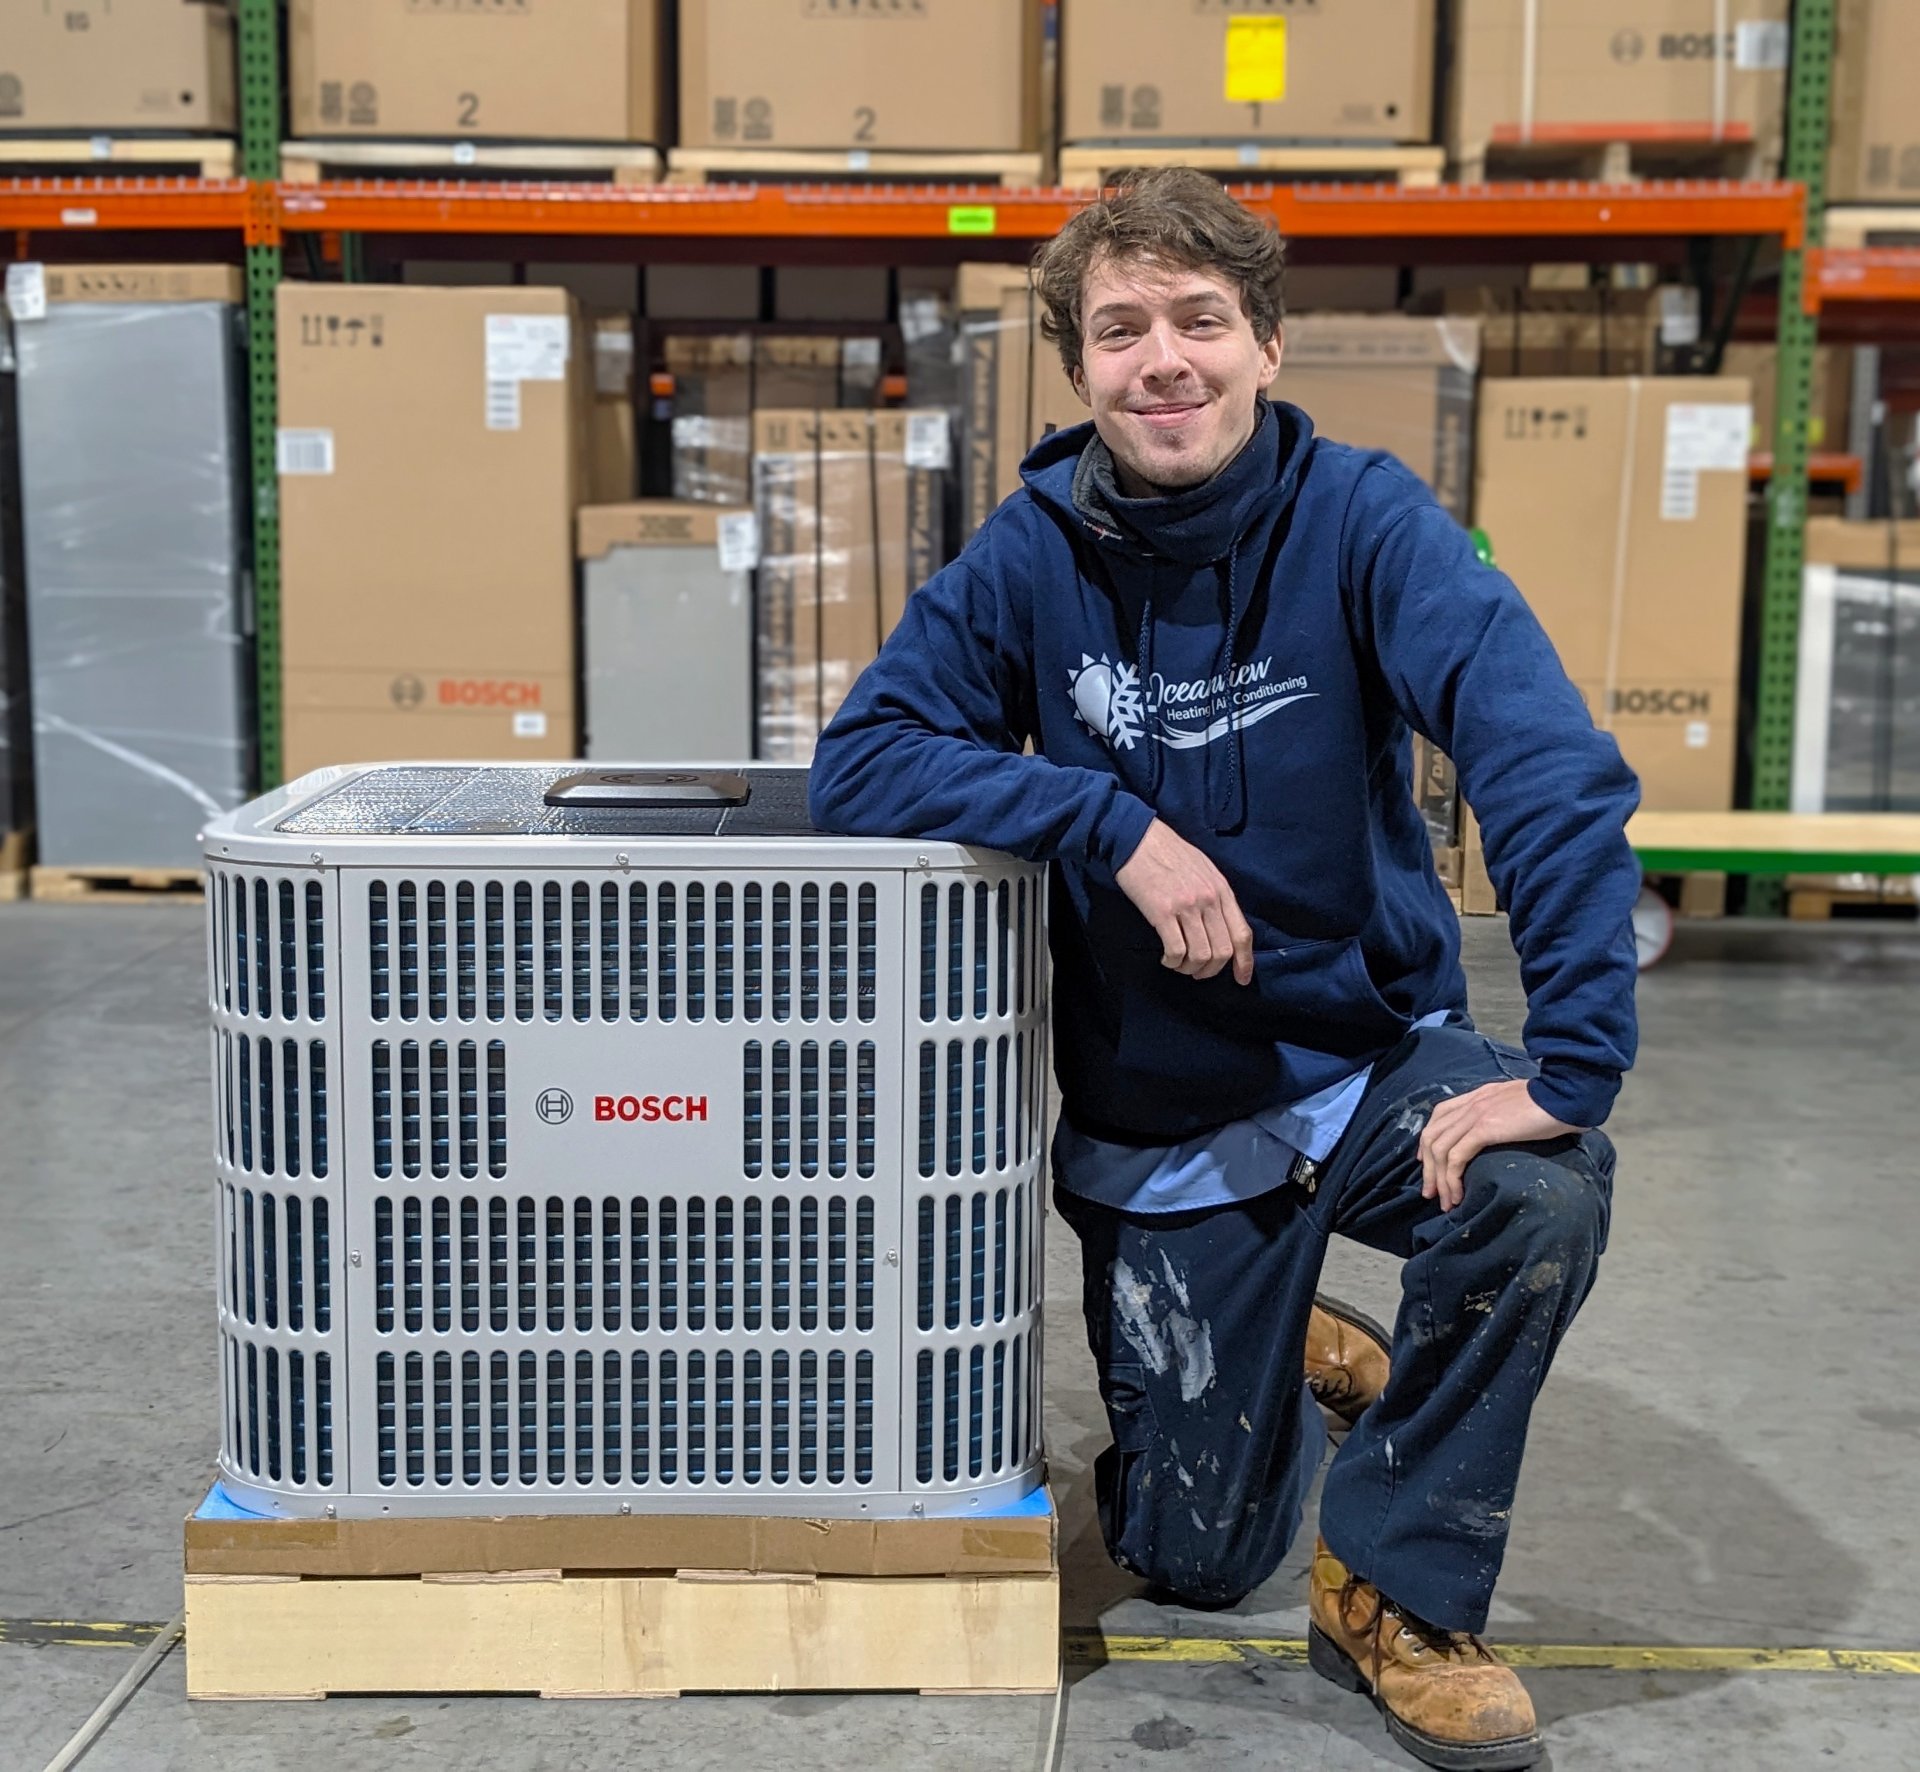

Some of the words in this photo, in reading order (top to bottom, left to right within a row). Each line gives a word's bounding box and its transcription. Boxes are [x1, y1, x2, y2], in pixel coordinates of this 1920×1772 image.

[1660, 34, 1737, 61] BOS
[457, 92, 480, 127] 2
[854, 106, 877, 142] 2
[438, 680, 541, 706] BOSCH
[1149, 655, 1272, 708] Oceaniew
[1166, 704, 1211, 722] Heating
[1216, 696, 1230, 711] Ai
[1232, 675, 1308, 705] Conditioning
[594, 1095, 708, 1122] BOSCH
